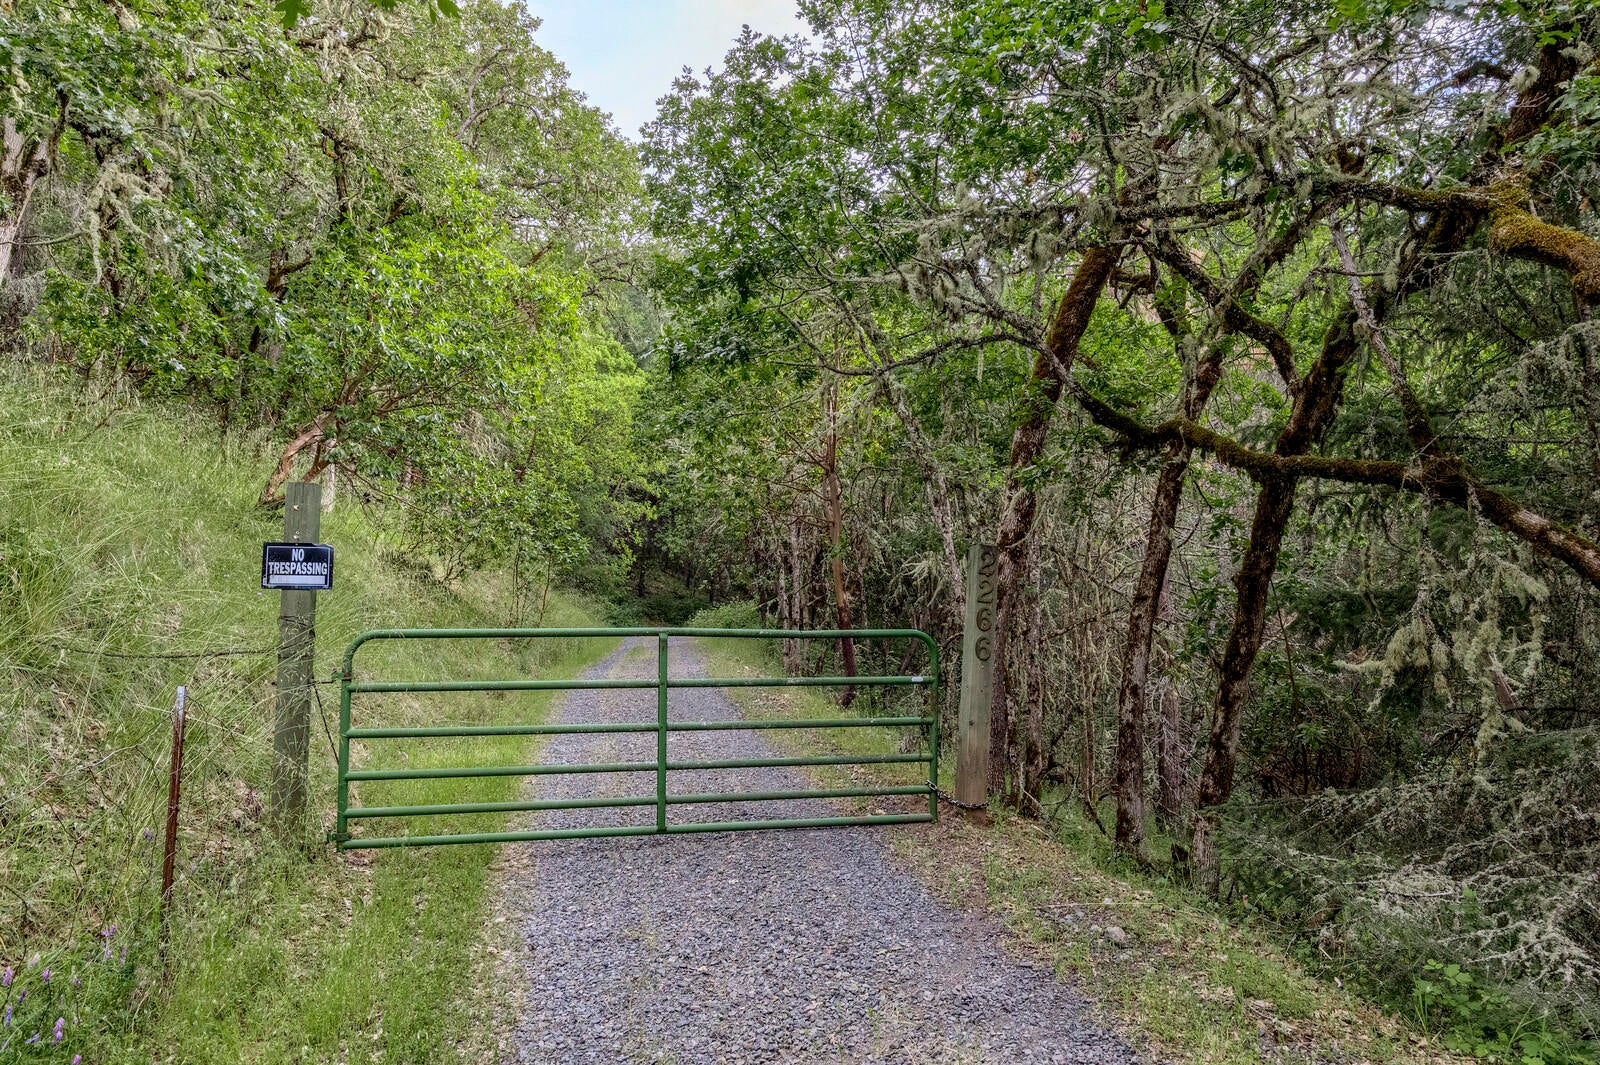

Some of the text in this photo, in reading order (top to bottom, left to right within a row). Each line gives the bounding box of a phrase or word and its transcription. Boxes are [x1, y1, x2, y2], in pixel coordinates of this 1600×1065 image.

[291, 548, 305, 562] NO
[268, 562, 328, 575] TRESPASSING
[975, 552, 995, 661] 2266
